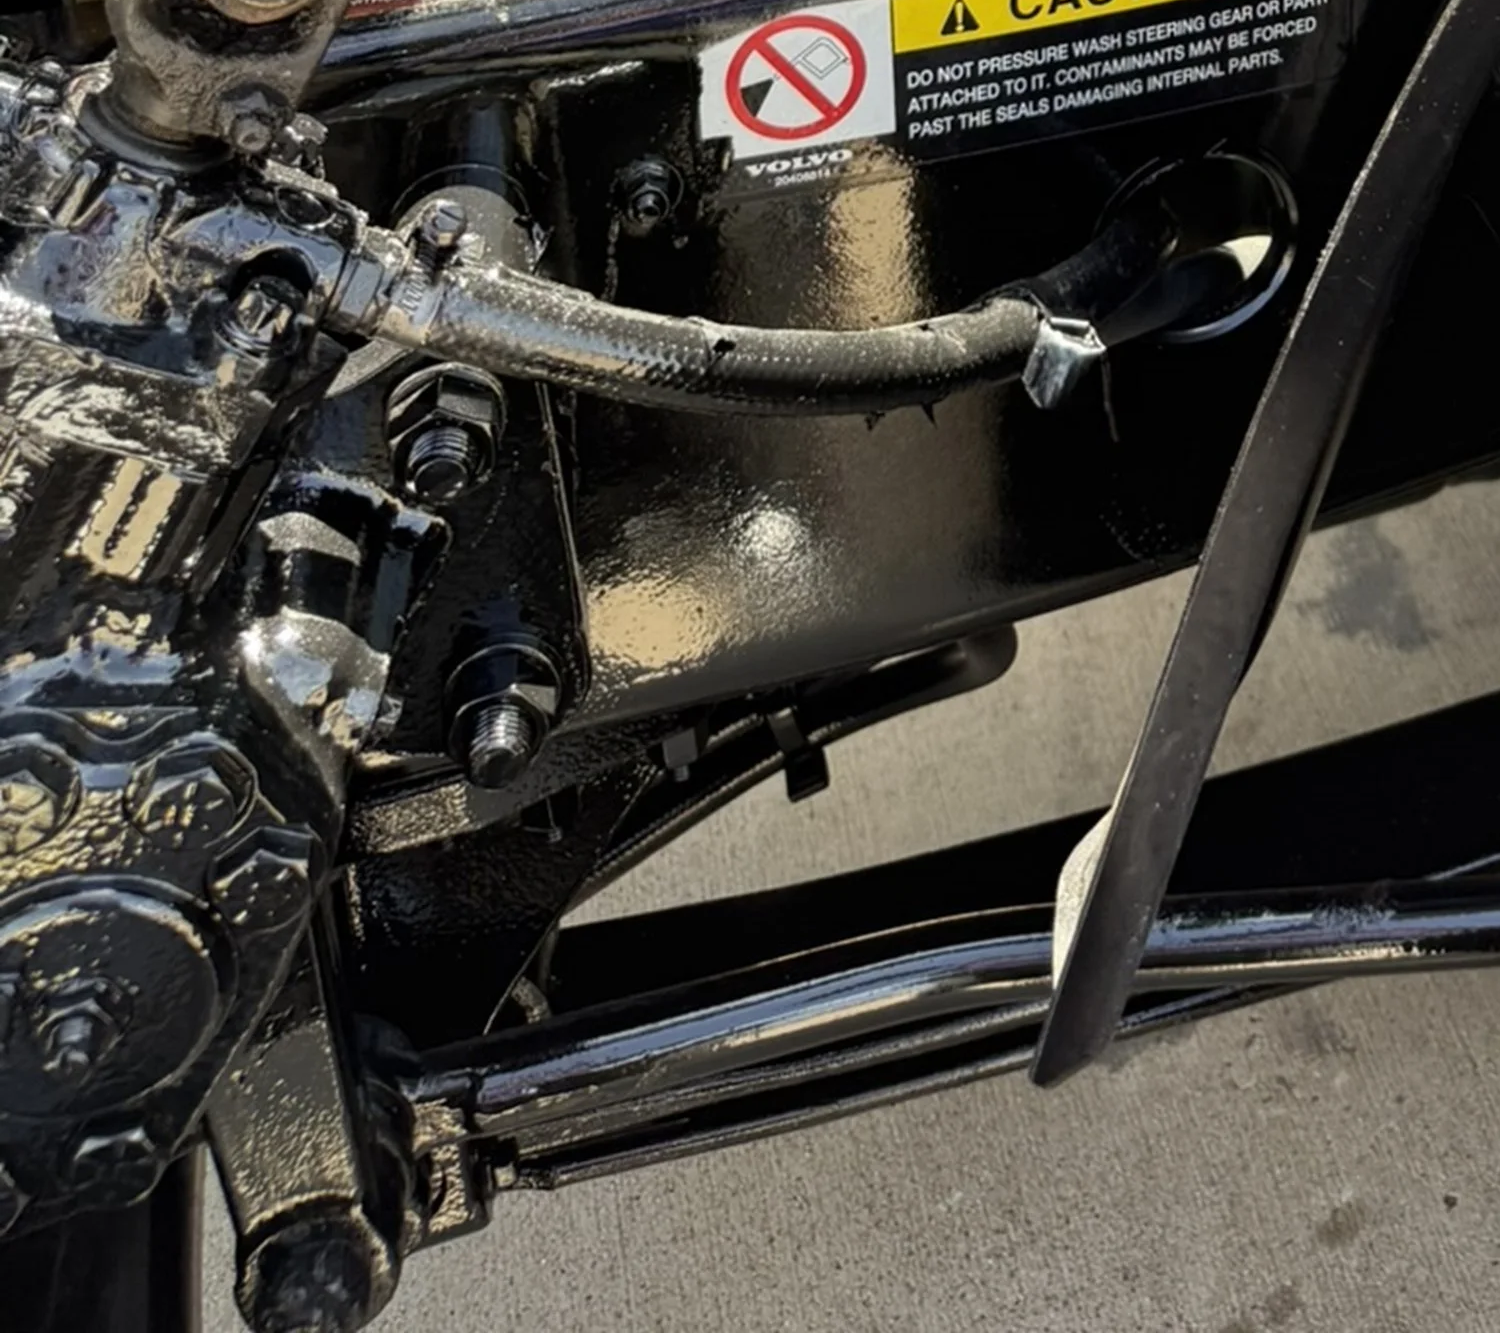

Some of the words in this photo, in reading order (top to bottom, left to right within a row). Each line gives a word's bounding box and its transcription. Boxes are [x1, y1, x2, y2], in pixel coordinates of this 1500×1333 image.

[907, 71, 934, 89] DO
[937, 61, 974, 82] NOT
[977, 43, 1069, 75] PRESSURE
[1072, 32, 1122, 58] WASH
[1126, 15, 1205, 47] STEERING
[1209, 5, 1253, 29] GEAR
[1256, 1, 1280, 18] OR
[907, 82, 1000, 115] ATTACHED
[1003, 79, 1027, 95] TO
[1030, 72, 1051, 91] IT.
[1054, 44, 1185, 85] CONTAMINANTS
[1188, 36, 1225, 59] MAY
[1228, 30, 1249, 50] BE
[1252, 16, 1317, 45] FORCED
[908, 115, 954, 139] PAST
[958, 109, 992, 130] THE
[995, 97, 1050, 124] SEALS
[1053, 78, 1143, 113] DAMAGING
[1147, 61, 1225, 93] INTERNAL
[1228, 48, 1284, 75] PARTS.
[744, 148, 853, 178] VOLVO
